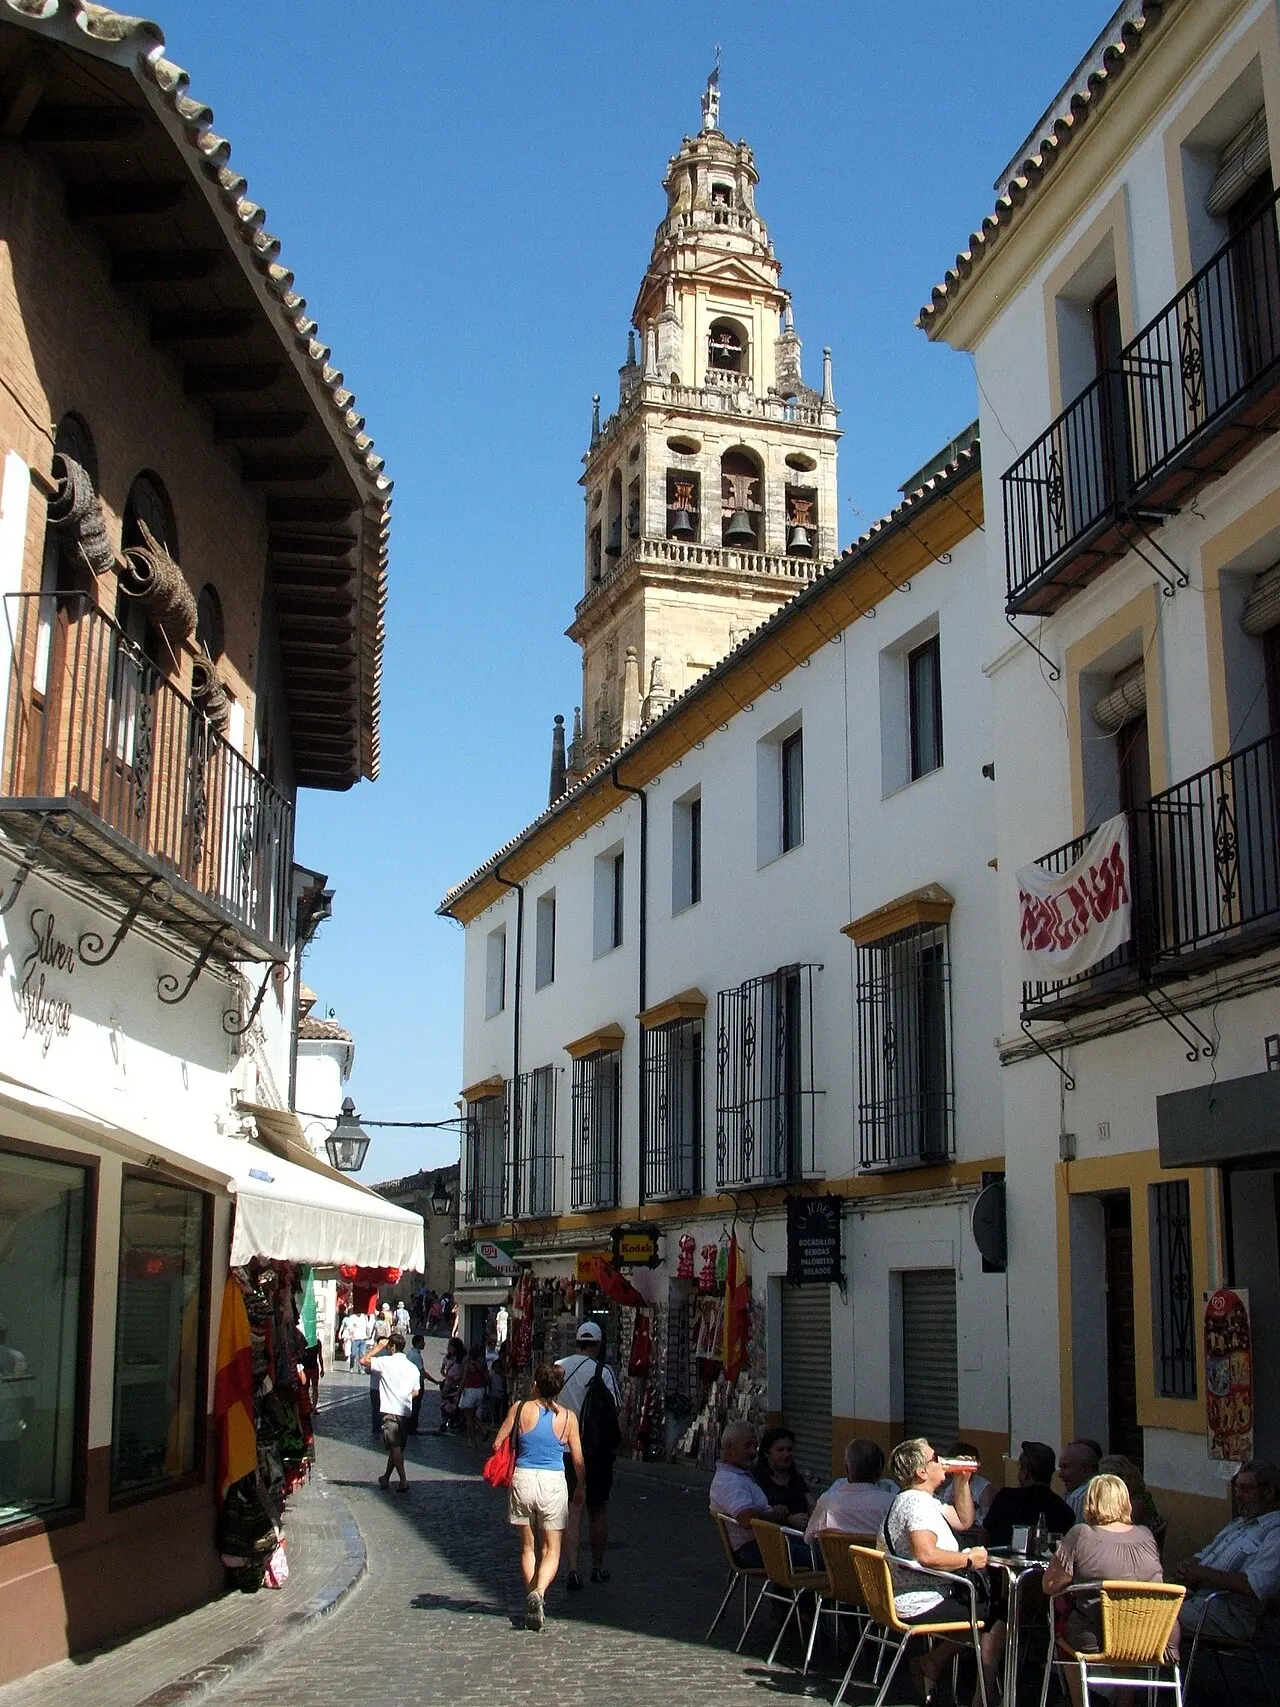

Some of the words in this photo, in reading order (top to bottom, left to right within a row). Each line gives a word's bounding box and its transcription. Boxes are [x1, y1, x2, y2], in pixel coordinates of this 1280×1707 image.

[23, 908, 75, 974] Silver
[798, 1239, 836, 1247] BOCADILLOS
[622, 1243, 653, 1253] Kodak
[800, 1257, 834, 1266] PALOMITAS
